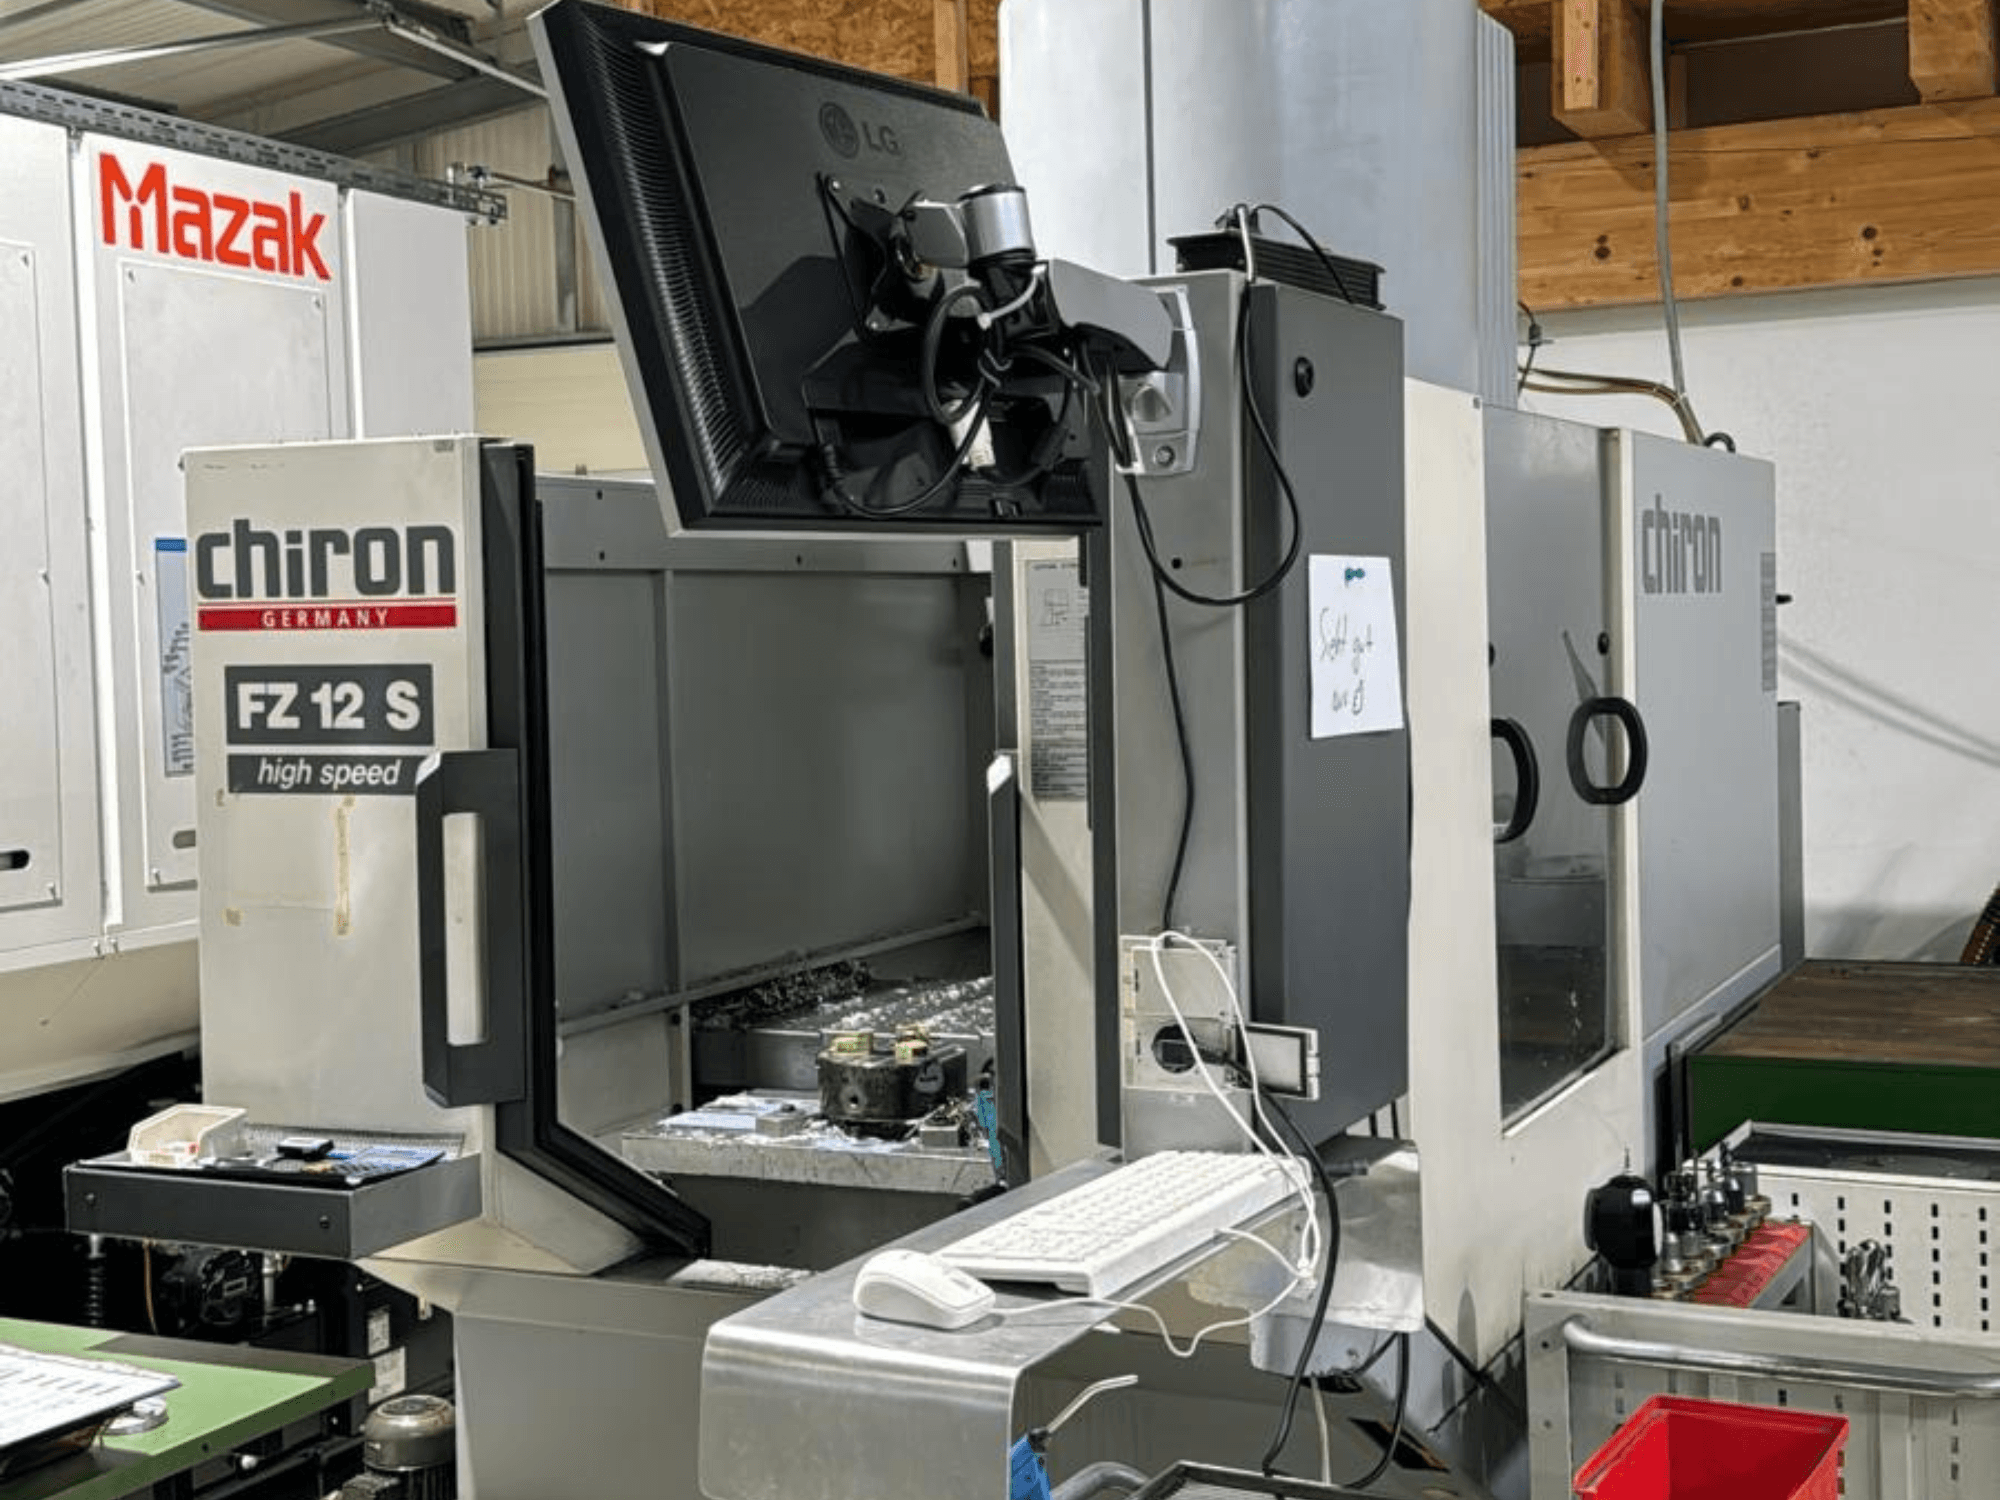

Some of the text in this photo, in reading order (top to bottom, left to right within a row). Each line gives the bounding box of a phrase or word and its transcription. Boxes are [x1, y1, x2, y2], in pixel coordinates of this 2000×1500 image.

[861, 121, 901, 156] LG
[98, 152, 331, 281] Mazak
[196, 518, 456, 598] chiron
[1641, 492, 1722, 595] chiron
[261, 608, 389, 629] GERMANY
[237, 680, 421, 731] FZ 12 S
[257, 757, 402, 790] high speed
